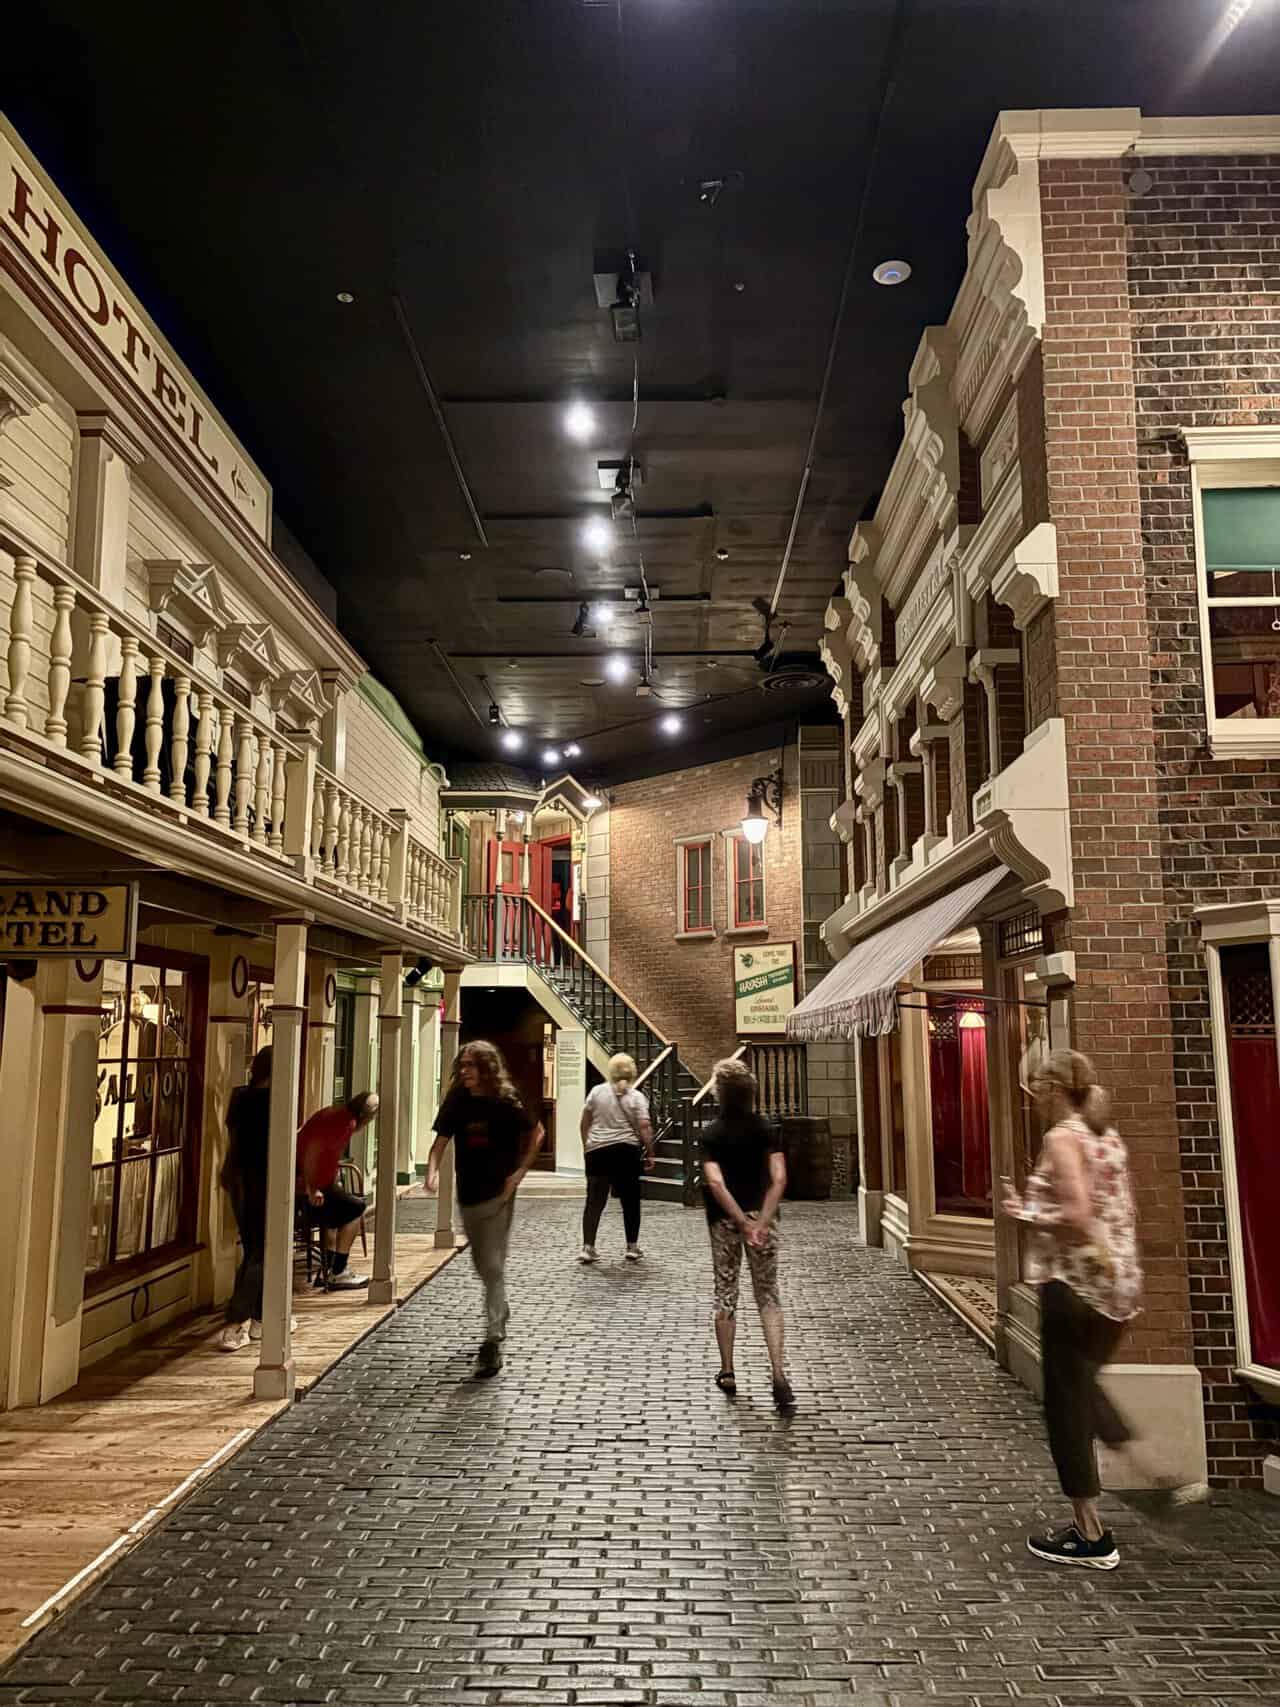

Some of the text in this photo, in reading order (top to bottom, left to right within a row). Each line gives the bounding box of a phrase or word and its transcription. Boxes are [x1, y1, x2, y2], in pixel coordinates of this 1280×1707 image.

[8, 165, 220, 475] HOTEL
[0, 891, 108, 917] AND
[0, 921, 97, 946] TEL
